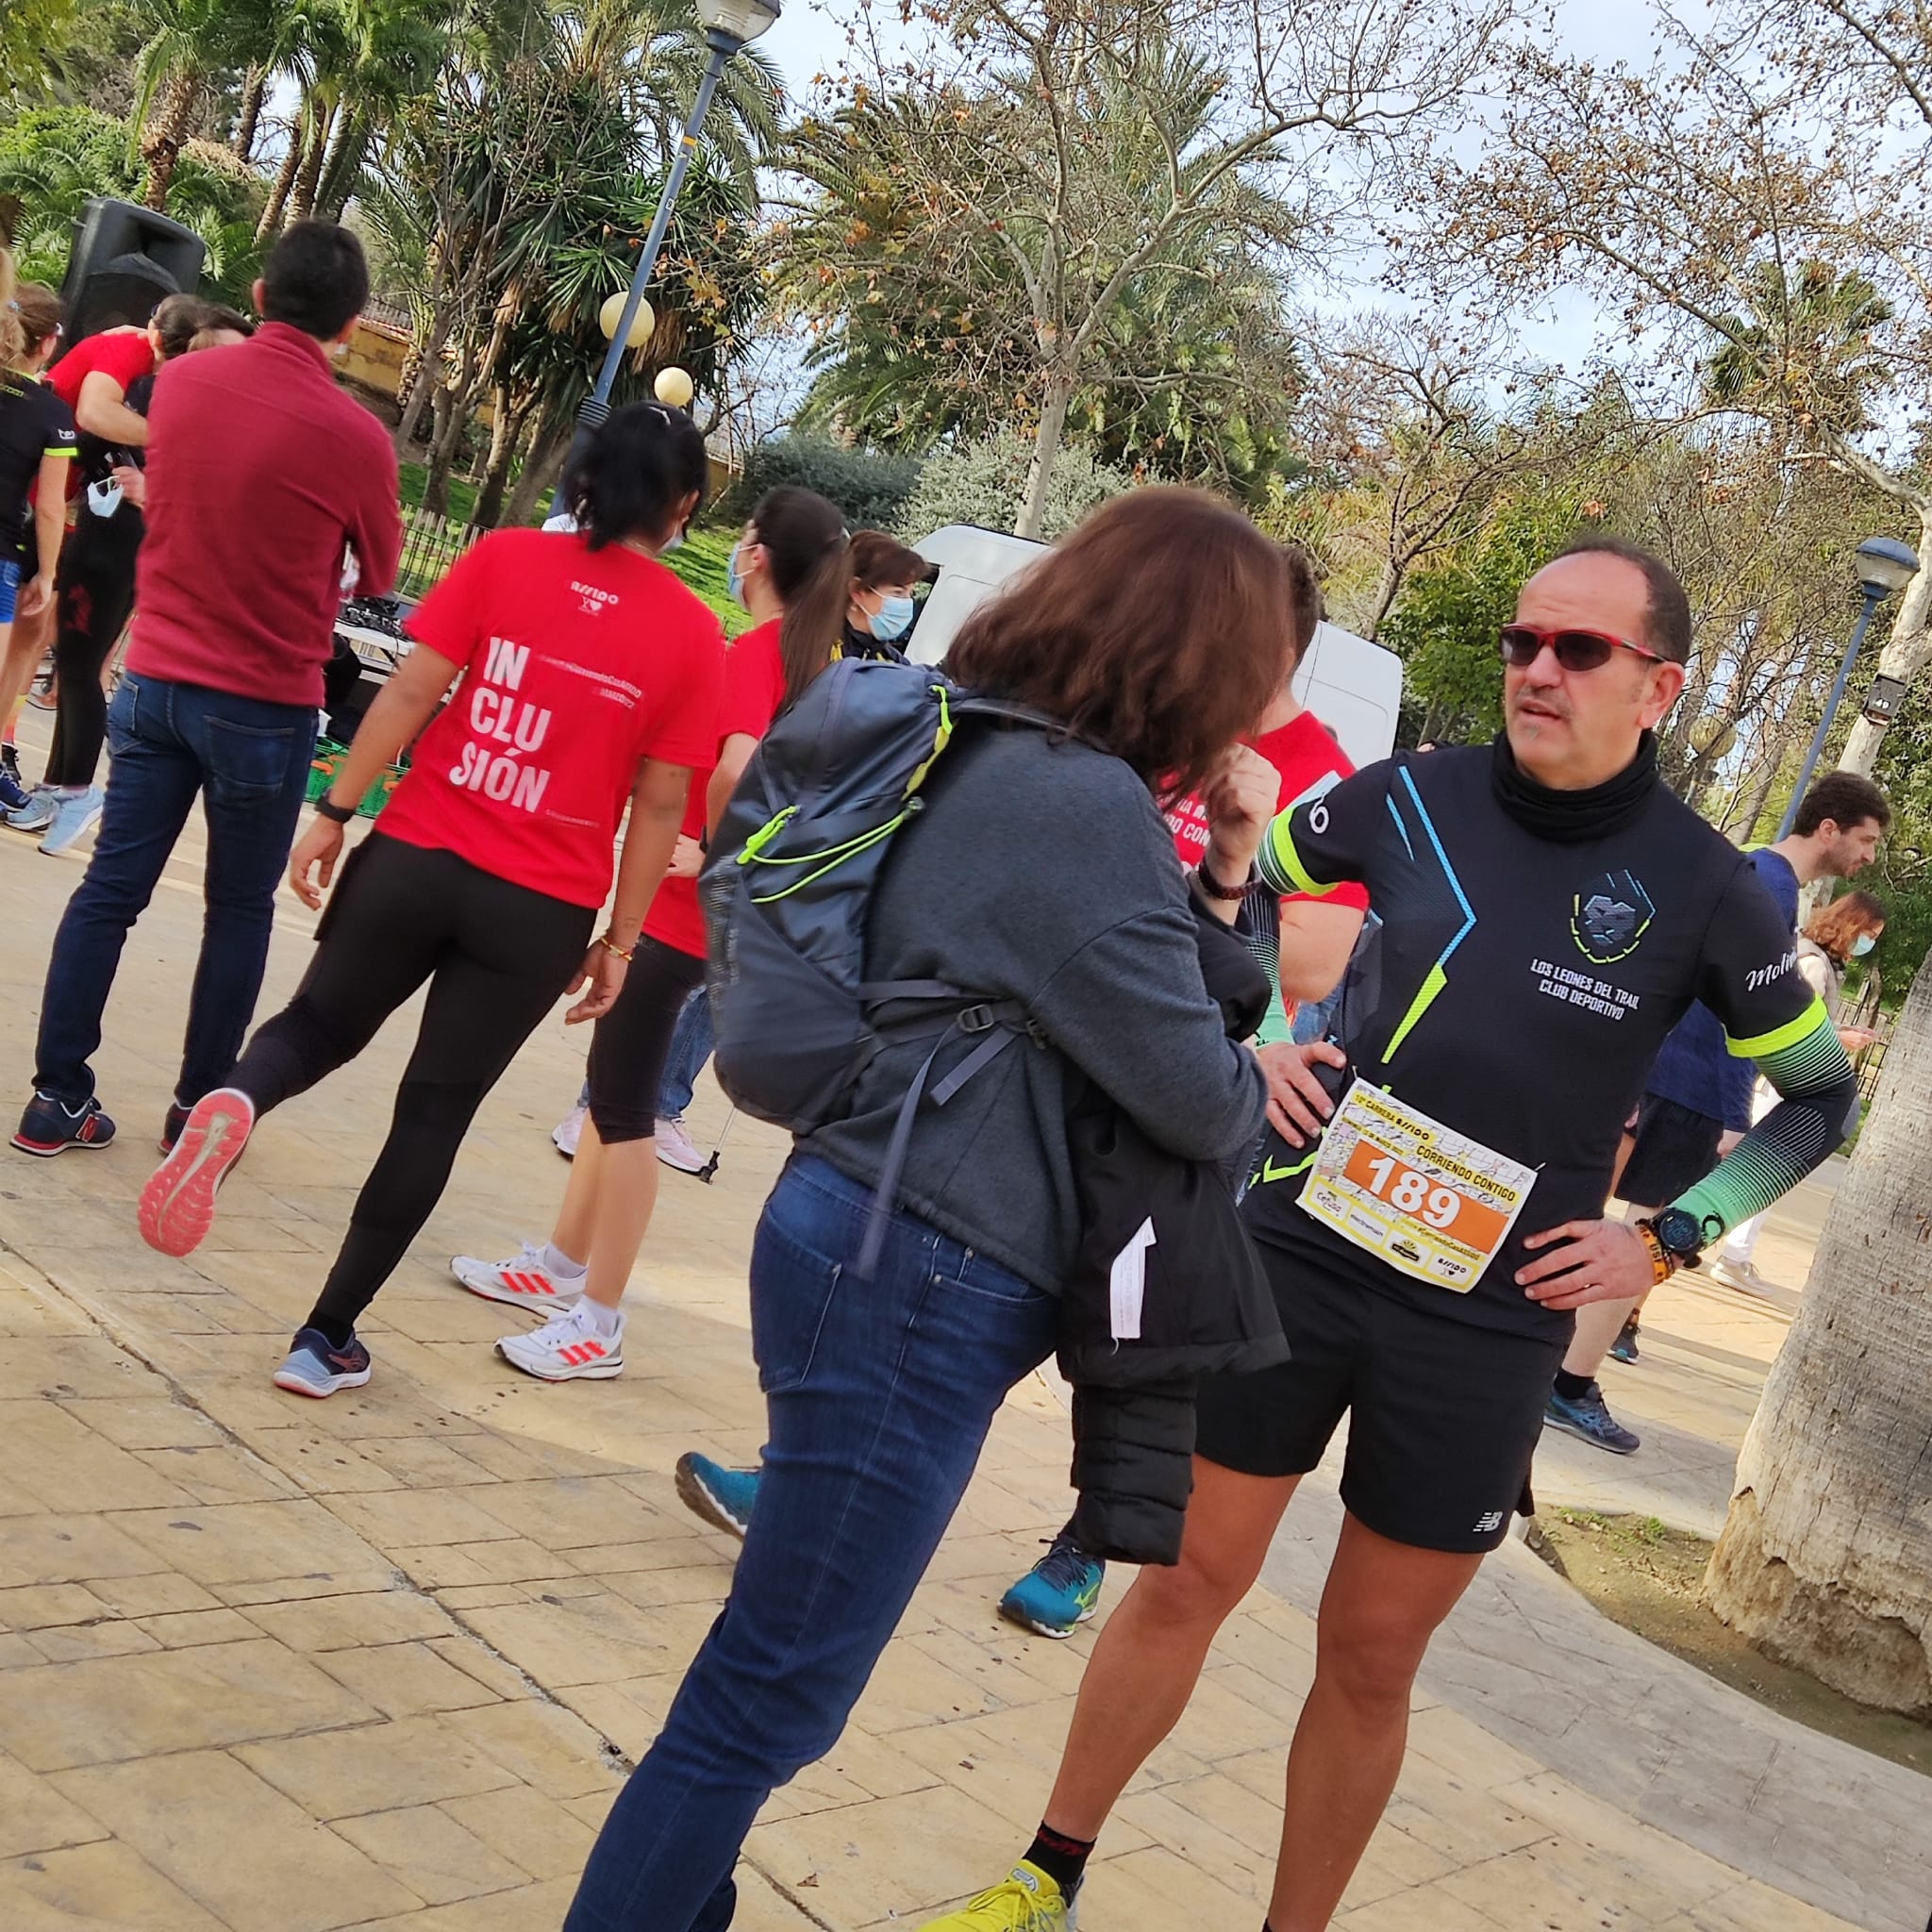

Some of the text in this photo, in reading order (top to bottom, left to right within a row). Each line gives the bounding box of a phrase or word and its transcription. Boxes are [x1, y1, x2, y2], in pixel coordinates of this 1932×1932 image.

[482, 636, 531, 691] IN
[470, 687, 552, 752] CLU
[449, 741, 551, 813] SIÓN
[1530, 958, 1640, 1010] LOS LEONES DEL TRAIL
[1539, 978, 1624, 1021] CLUB DEPORTIVO
[1368, 1157, 1460, 1228] 189
[1416, 1144, 1516, 1202] CORRIENDO CONTIGO
